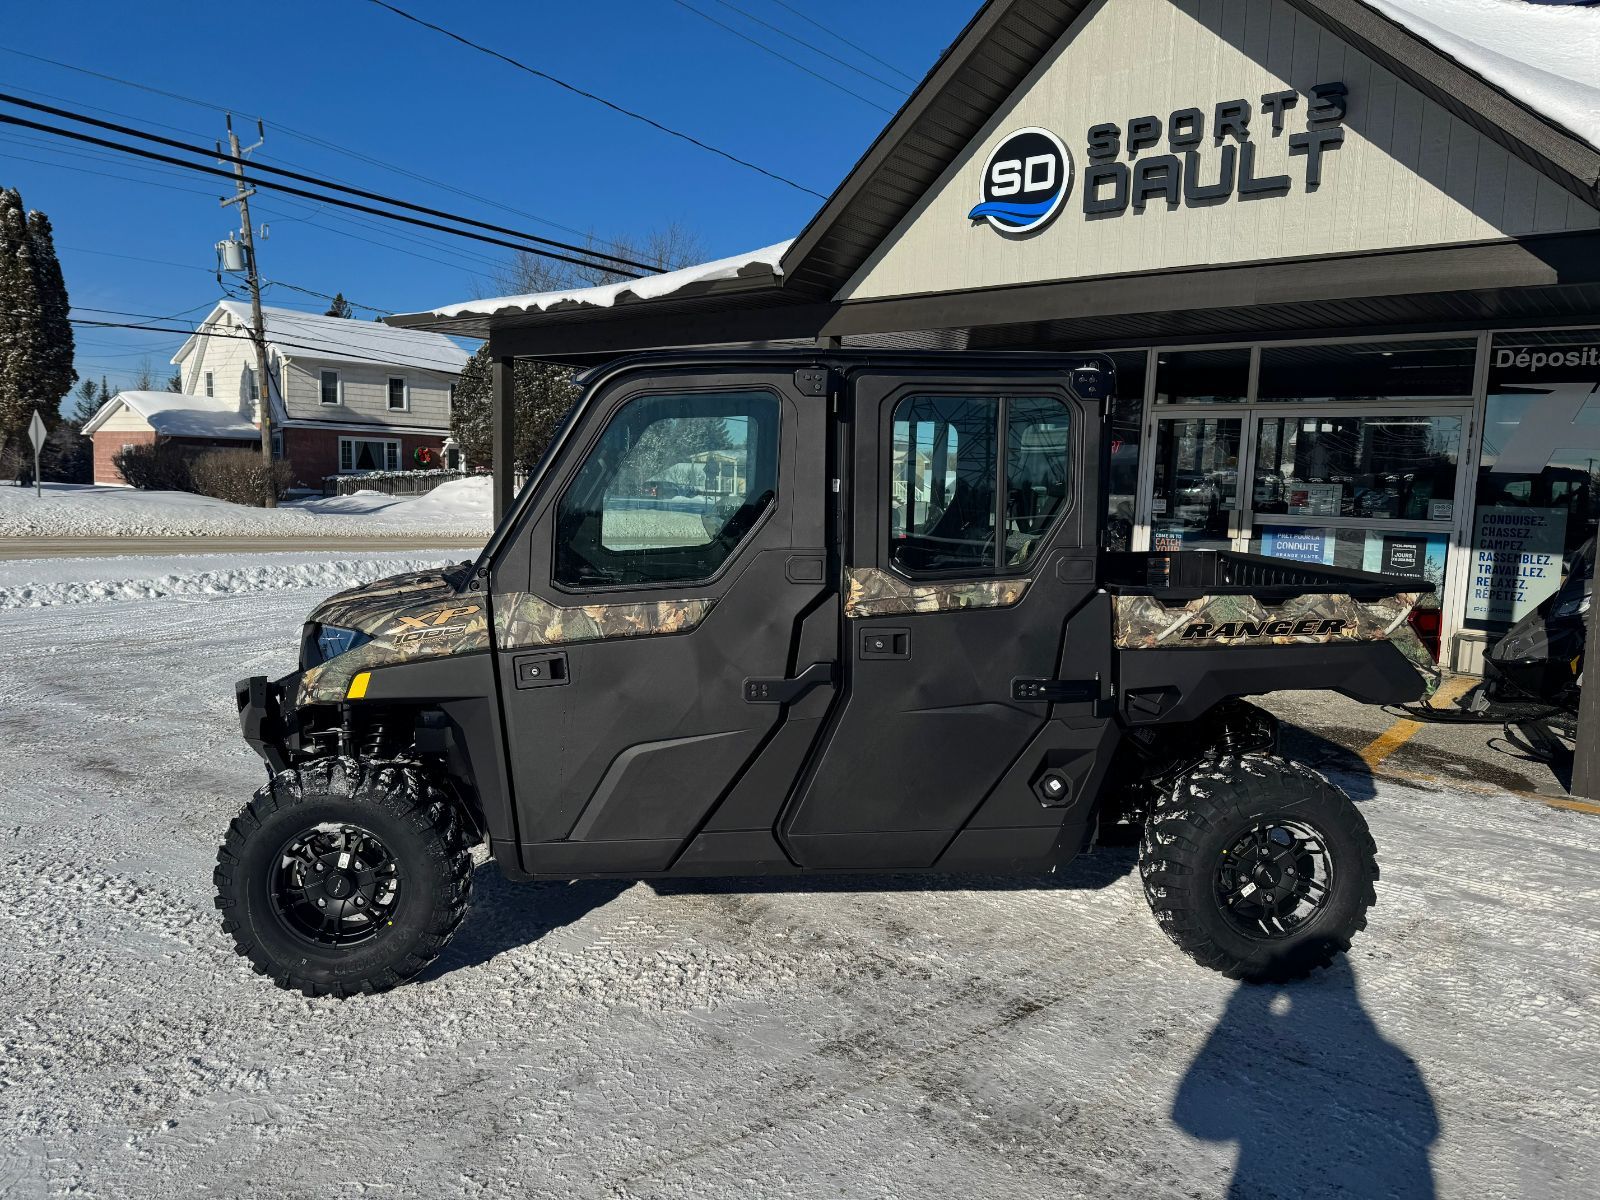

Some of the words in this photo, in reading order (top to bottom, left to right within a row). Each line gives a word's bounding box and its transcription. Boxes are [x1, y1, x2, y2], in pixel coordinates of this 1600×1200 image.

[1087, 81, 1349, 159] SPORTS
[991, 154, 1056, 197] SD
[1083, 127, 1345, 216] DAULT
[1496, 347, 1600, 372] Déposit
[1482, 514, 1548, 526] CONDUISEZ.
[1481, 527, 1533, 539] CHASSEZ.
[1155, 538, 1181, 546] CATCH
[1276, 541, 1320, 552] CONDUITE
[1480, 539, 1527, 551] CAMPEZ.
[1479, 552, 1553, 565] RASSEMBLEZ.
[1478, 564, 1547, 578] TRAVAILLEZ.
[1476, 577, 1528, 590] RELAXEZ.
[391, 604, 481, 631] XP
[394, 623, 466, 645] 1000
[1181, 618, 1347, 640] RANGER
